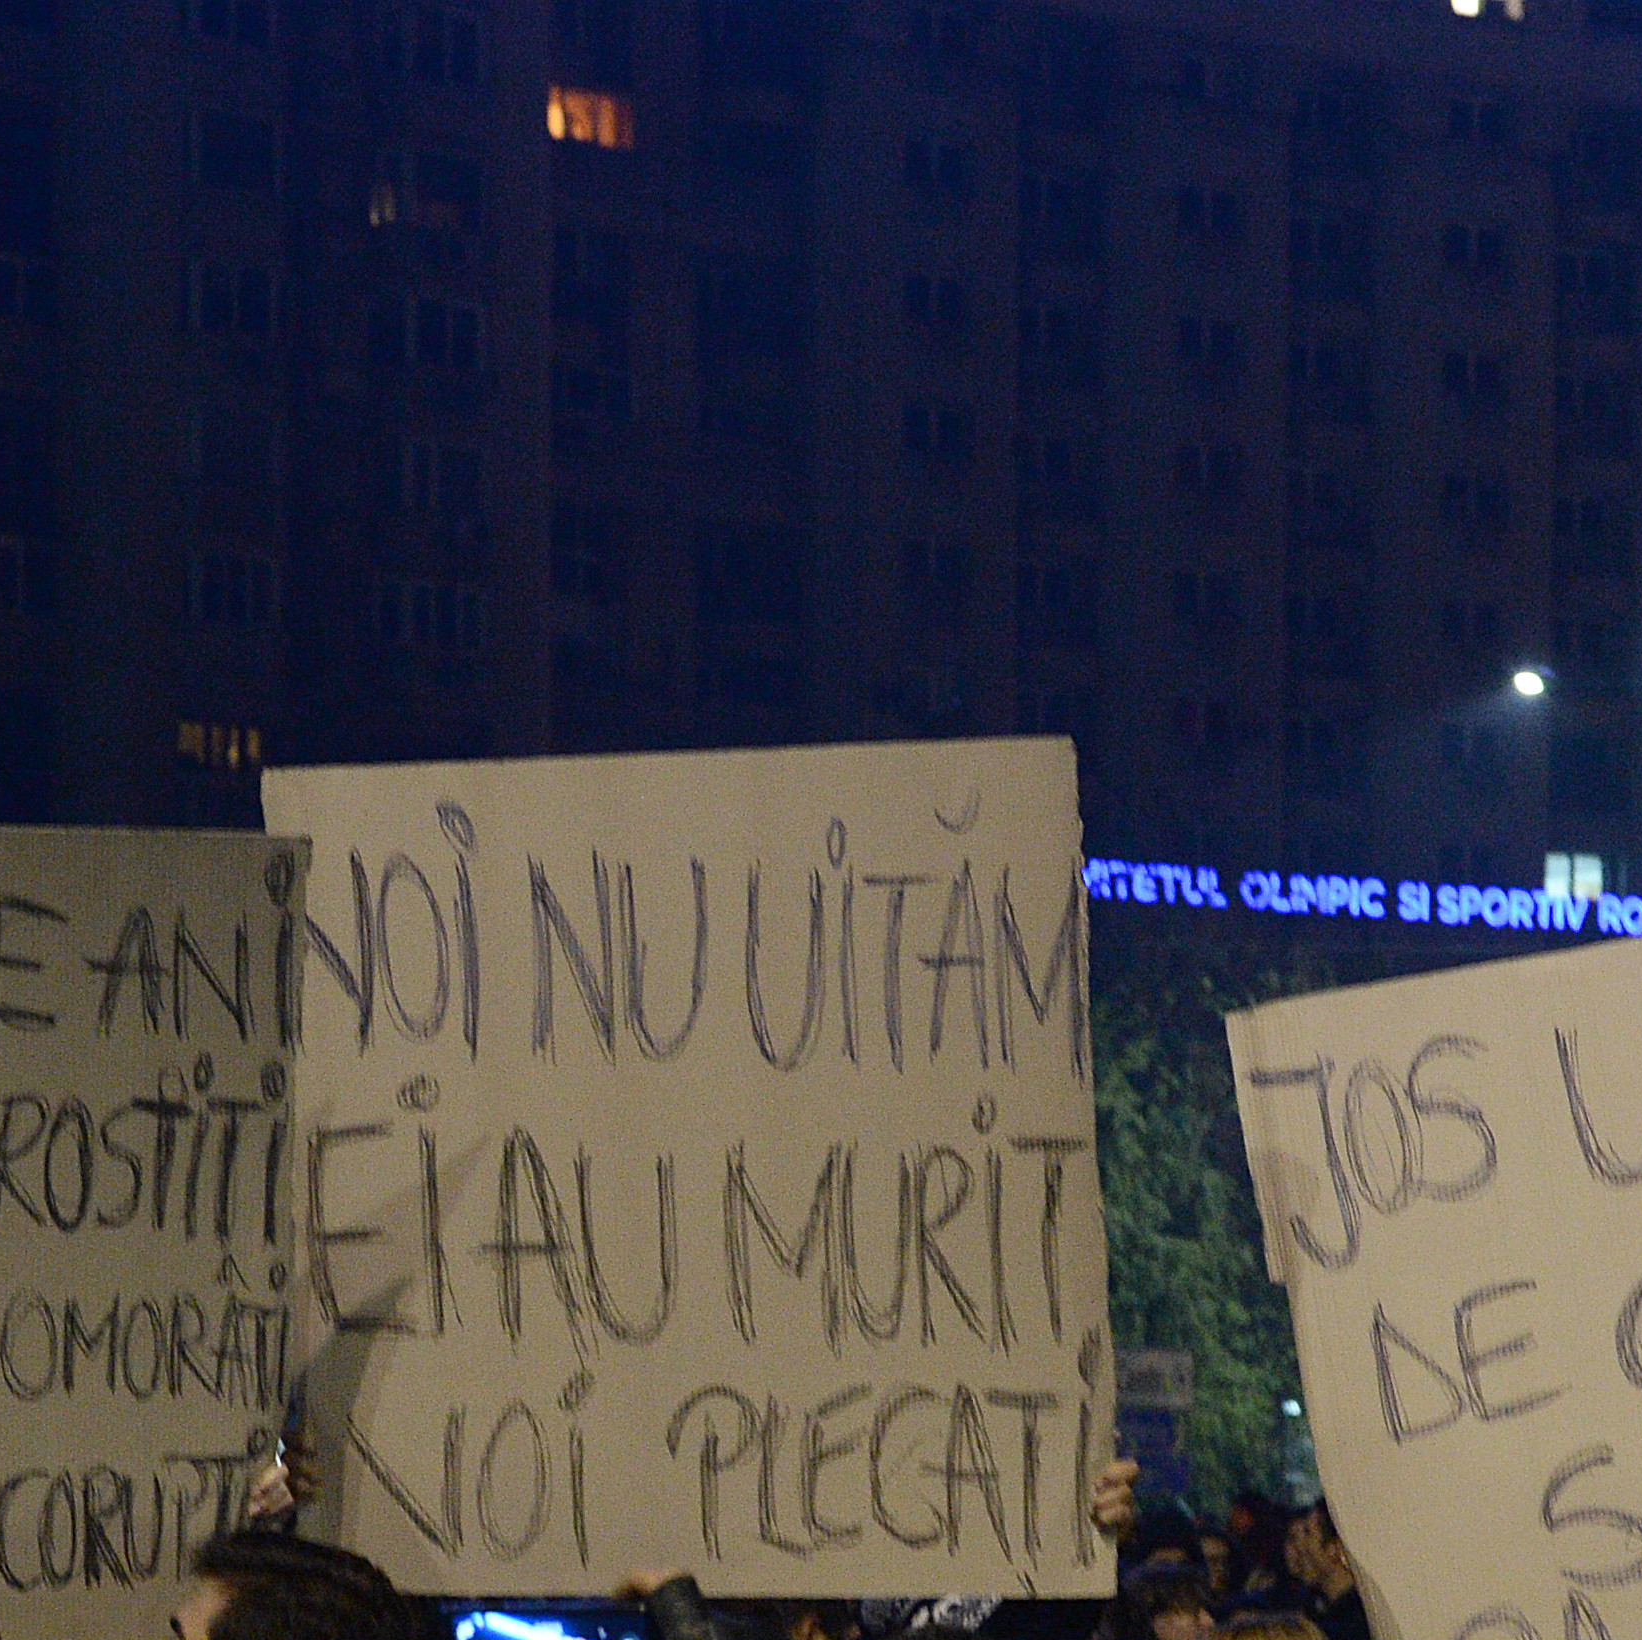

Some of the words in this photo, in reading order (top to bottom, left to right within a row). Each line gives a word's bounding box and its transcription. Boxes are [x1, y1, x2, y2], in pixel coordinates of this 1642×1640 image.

[84, 850, 305, 1056] ANI
[528, 848, 707, 1066] NU
[1238, 869, 1387, 920] OLIMPIC
[1397, 879, 1431, 922] SI
[1436, 882, 1590, 933] SPORTIV
[306, 1074, 464, 1338] EI
[477, 1123, 677, 1363] AU
[723, 1095, 1088, 1357] MURIT
[1249, 1034, 1499, 1269] JOS
[1369, 1278, 1572, 1446] DE
